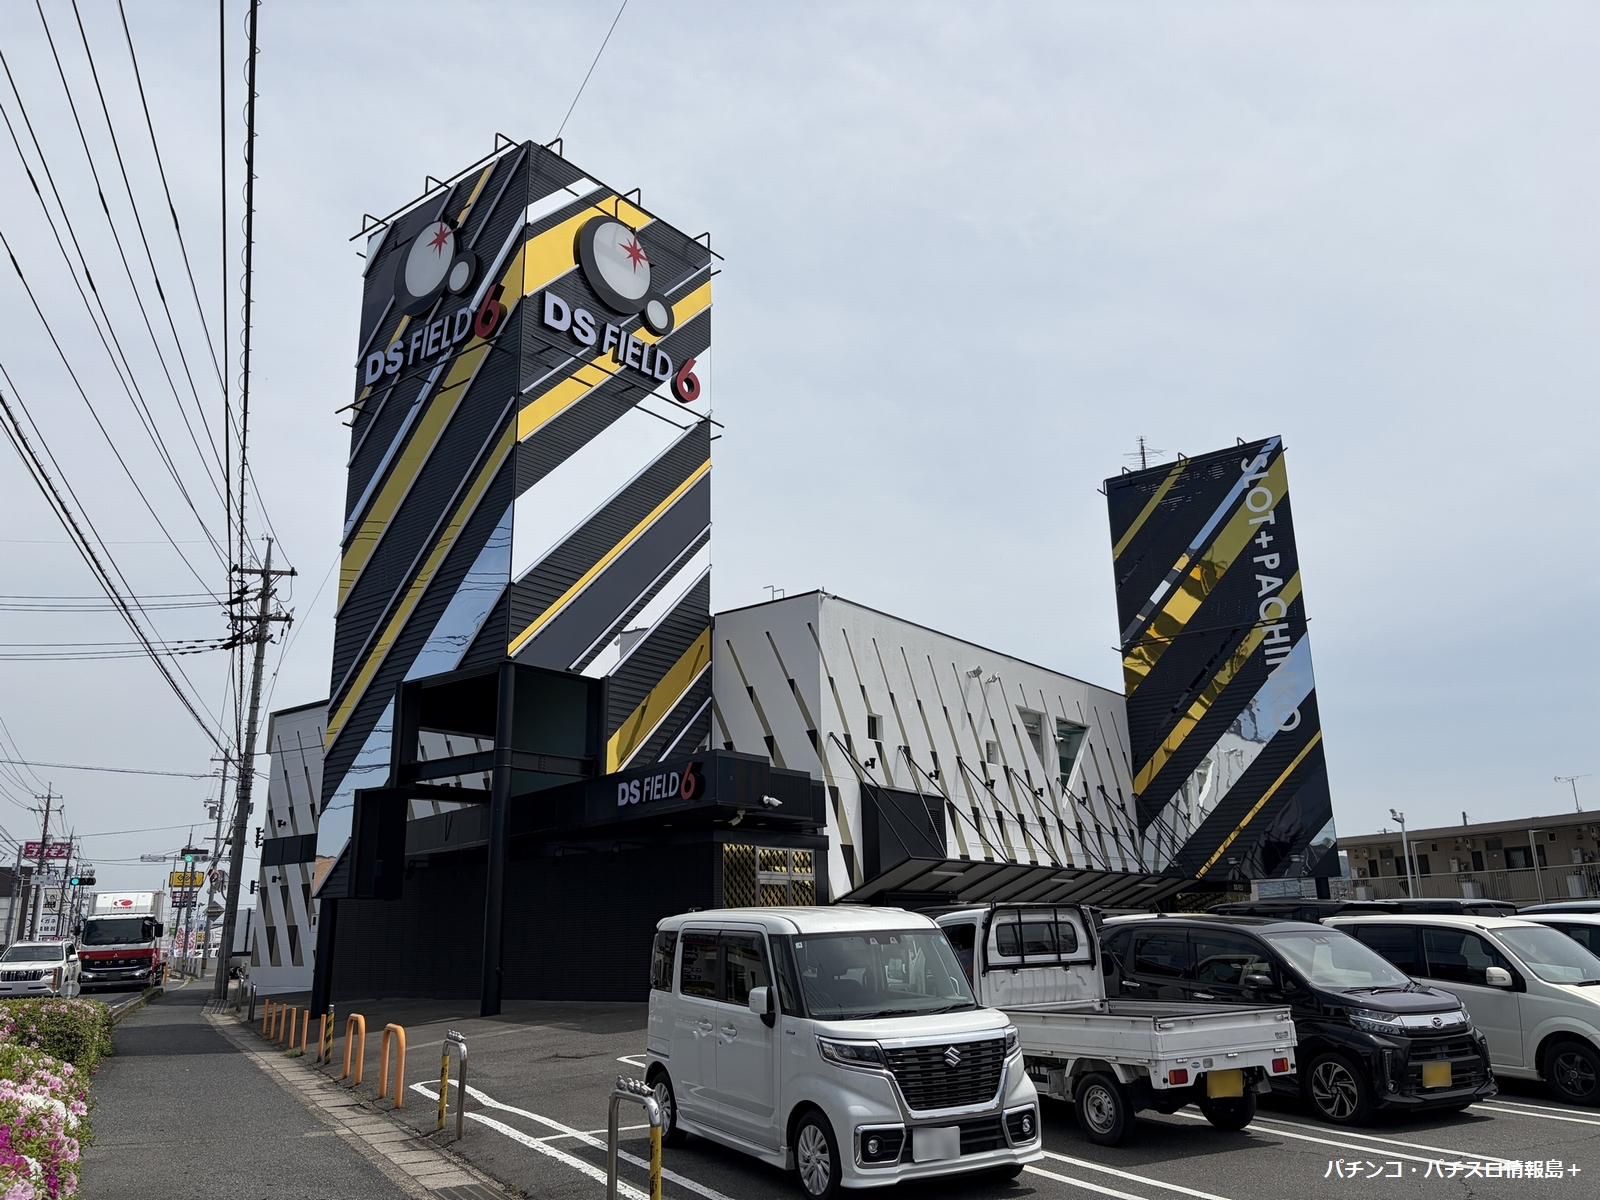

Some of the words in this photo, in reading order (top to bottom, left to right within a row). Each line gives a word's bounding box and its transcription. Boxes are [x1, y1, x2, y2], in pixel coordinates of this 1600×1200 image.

[365, 339, 404, 386] DS
[408, 307, 472, 366] FIELD
[474, 283, 502, 338] 6
[544, 290, 597, 347] DS
[602, 321, 674, 381] FIELD
[674, 358, 701, 403] 6
[617, 779, 640, 807] DS
[642, 771, 680, 802] FIELD
[680, 761, 696, 800] 6
